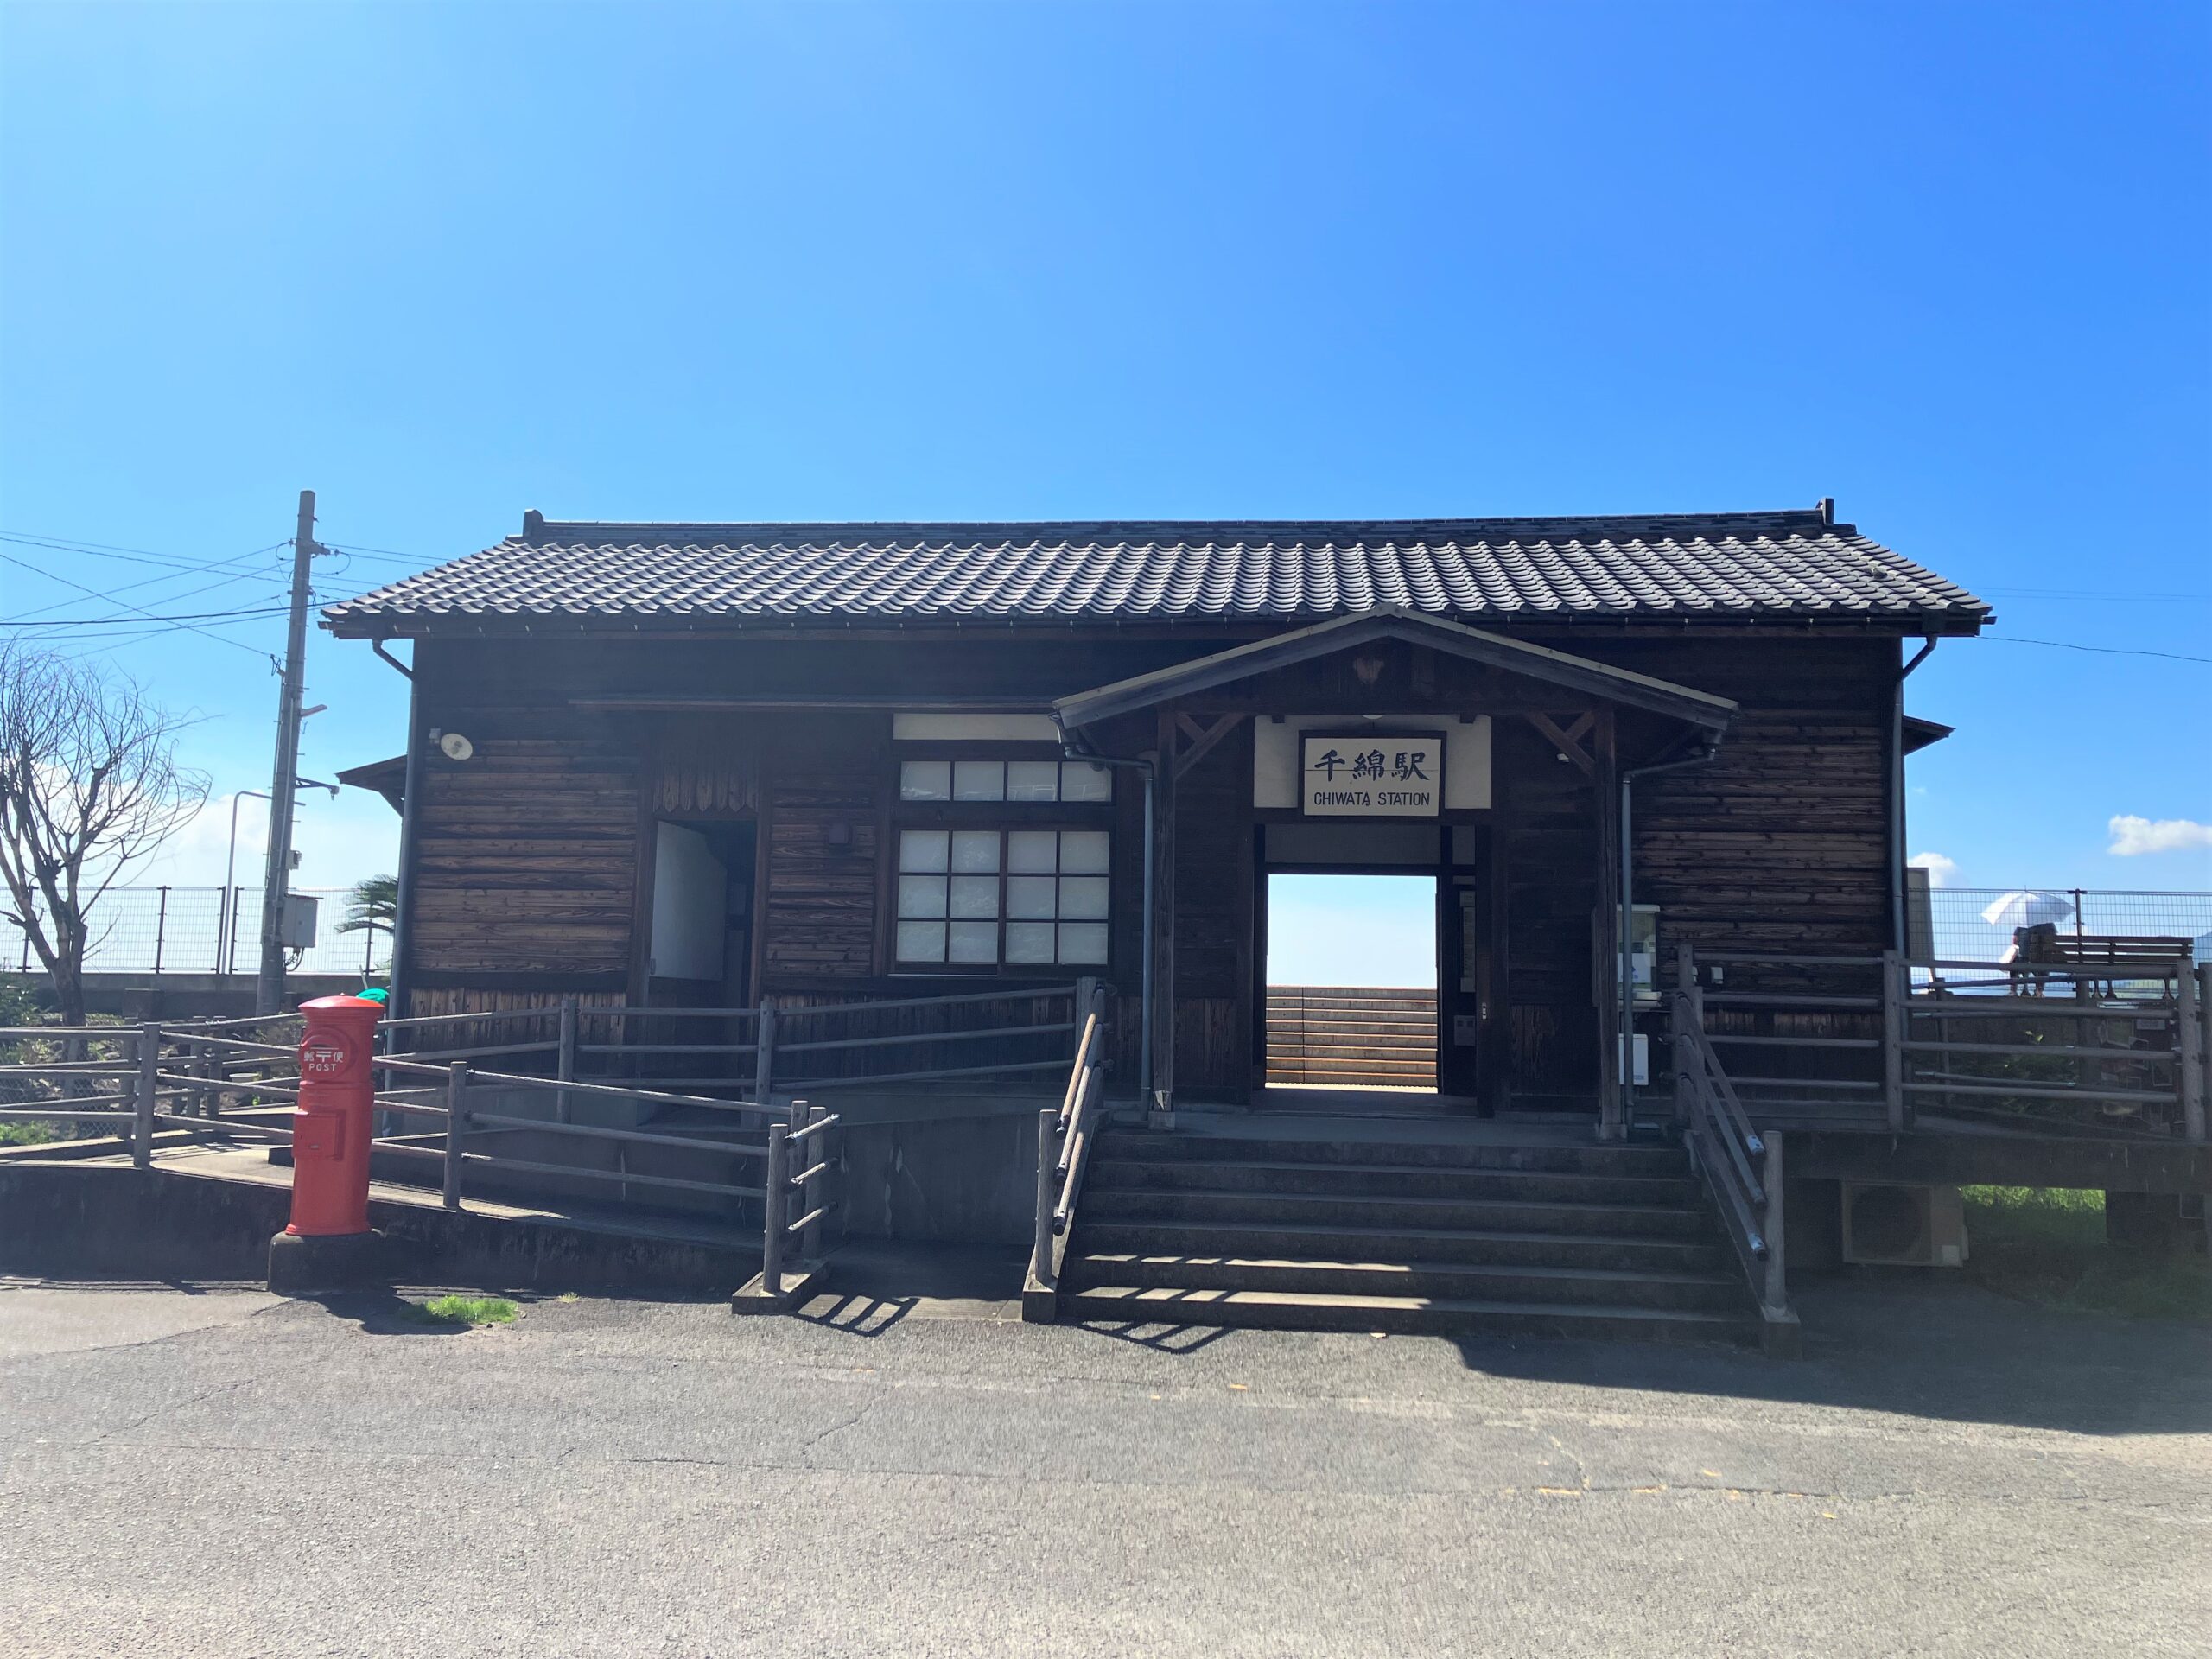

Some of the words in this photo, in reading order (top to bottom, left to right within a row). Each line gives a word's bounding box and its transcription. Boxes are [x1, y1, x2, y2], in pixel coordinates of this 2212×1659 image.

[1314, 749, 1430, 782] 千綿駅
[1313, 791, 1371, 806] CHIWATA
[1377, 791, 1430, 806] STATION
[308, 1063, 337, 1071] POST
